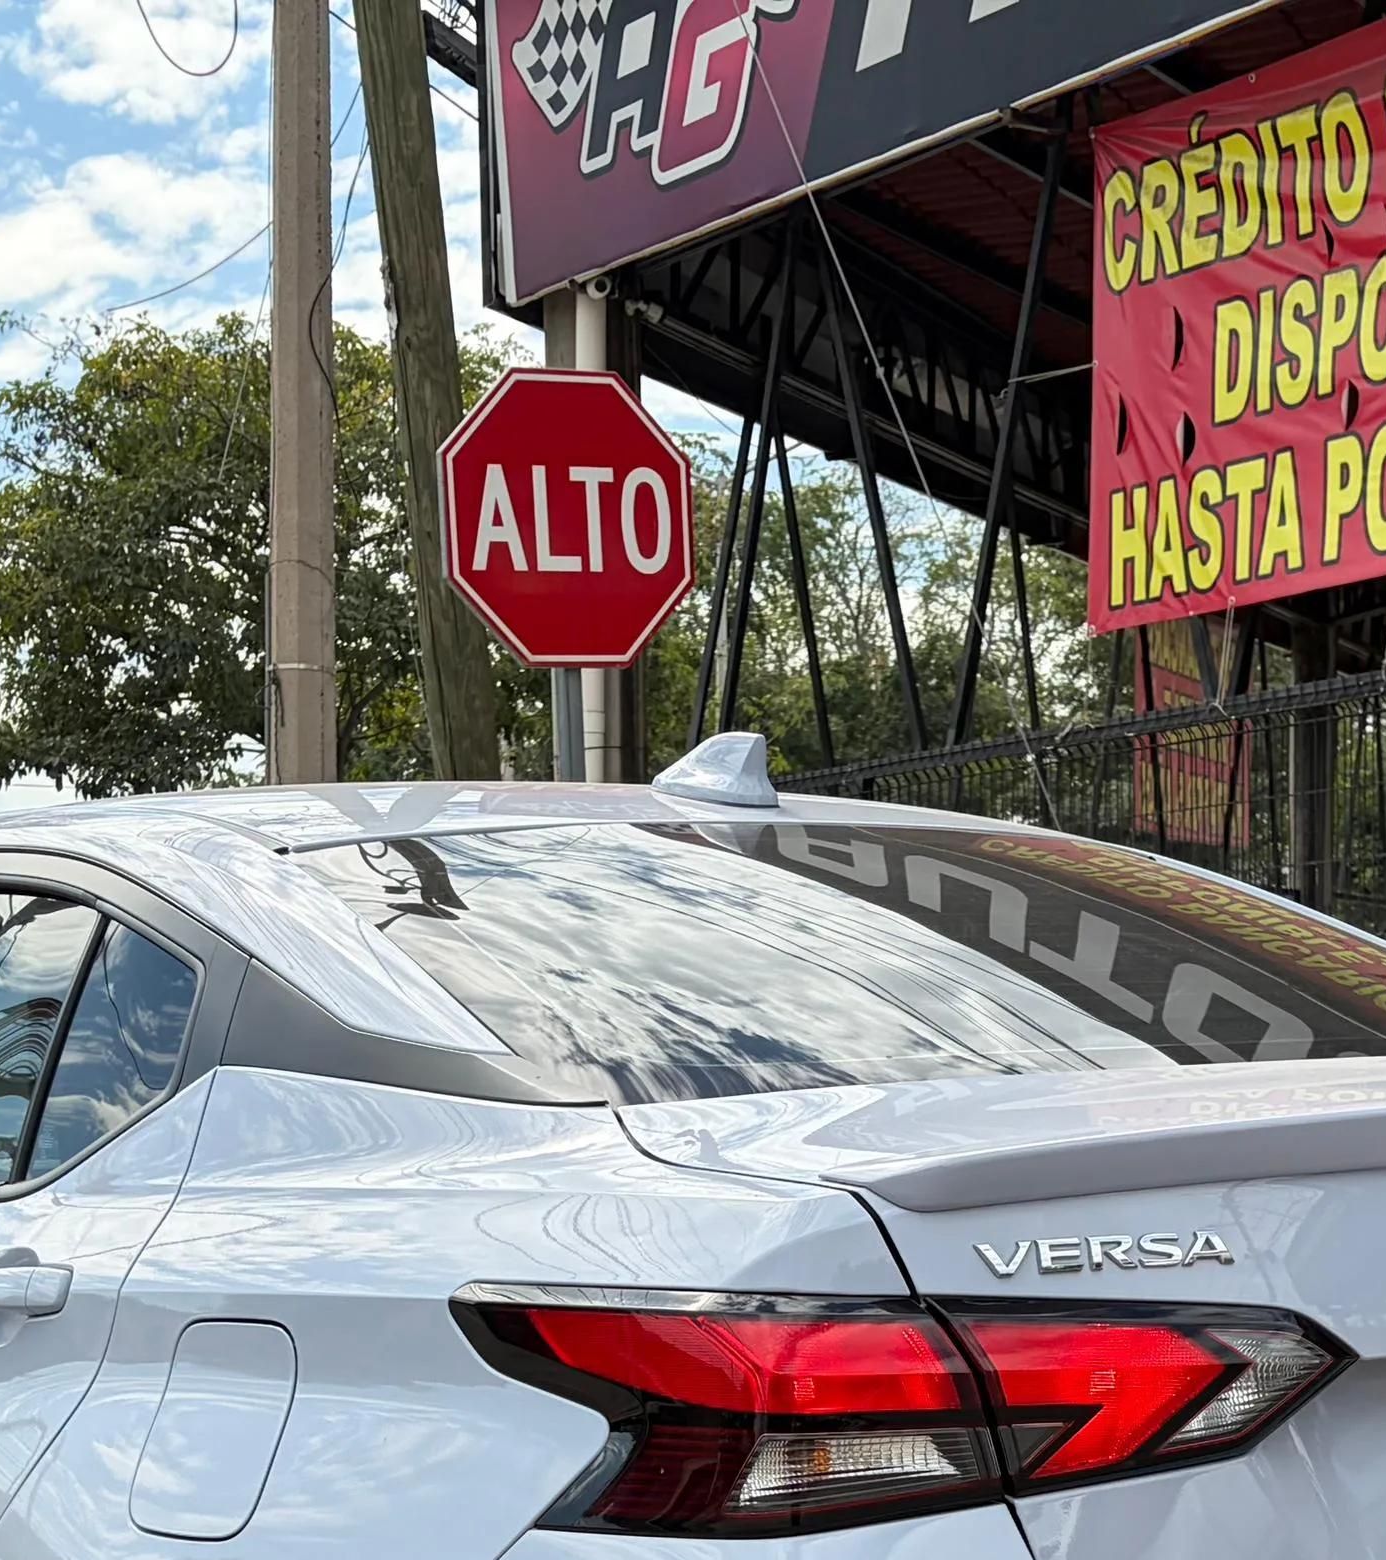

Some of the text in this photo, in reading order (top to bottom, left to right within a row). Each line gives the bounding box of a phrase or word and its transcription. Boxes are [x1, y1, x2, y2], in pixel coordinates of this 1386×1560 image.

[1101, 86, 1372, 295] CRÉDITO
[473, 464, 671, 575] ALTO
[1107, 447, 1304, 610] HASTA
[972, 1229, 1235, 1279] VERSA
